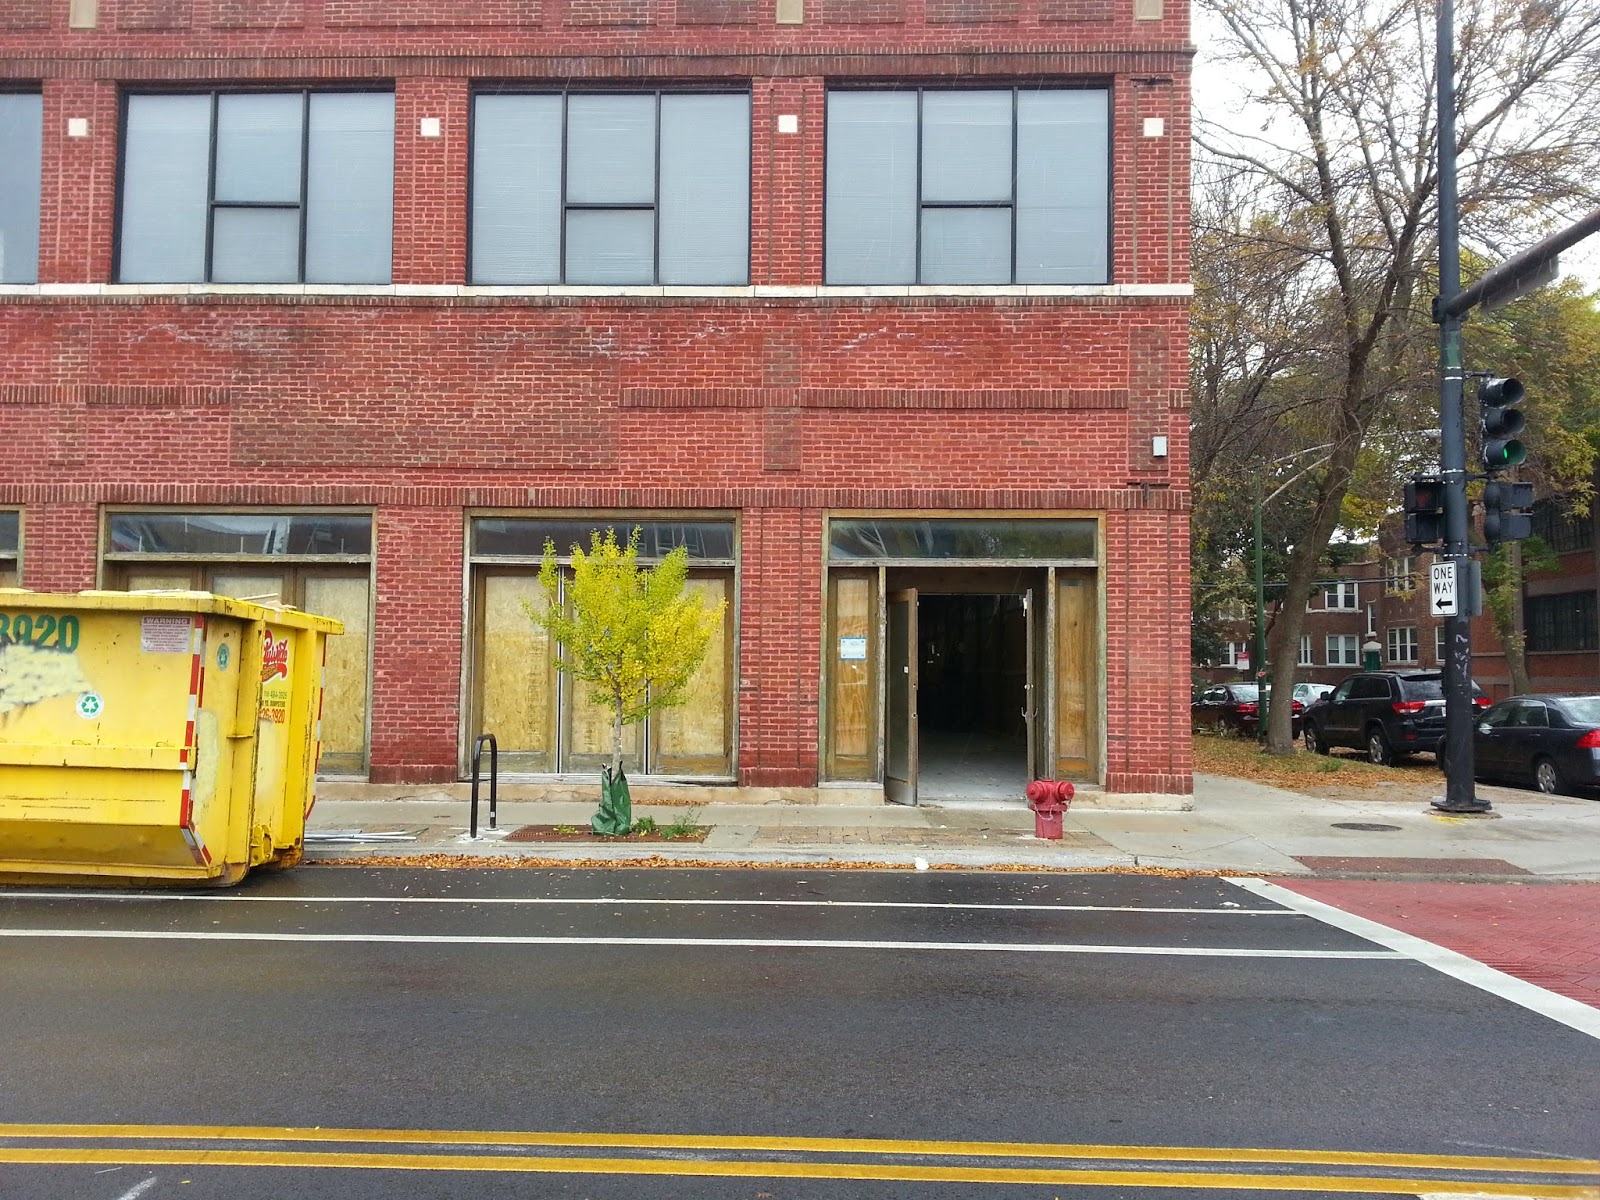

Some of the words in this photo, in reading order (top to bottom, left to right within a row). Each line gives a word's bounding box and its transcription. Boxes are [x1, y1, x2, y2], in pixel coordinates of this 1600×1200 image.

[1433, 567, 1453, 580] ONE
[1433, 581, 1454, 595] WAY
[146, 617, 188, 625] WARNING
